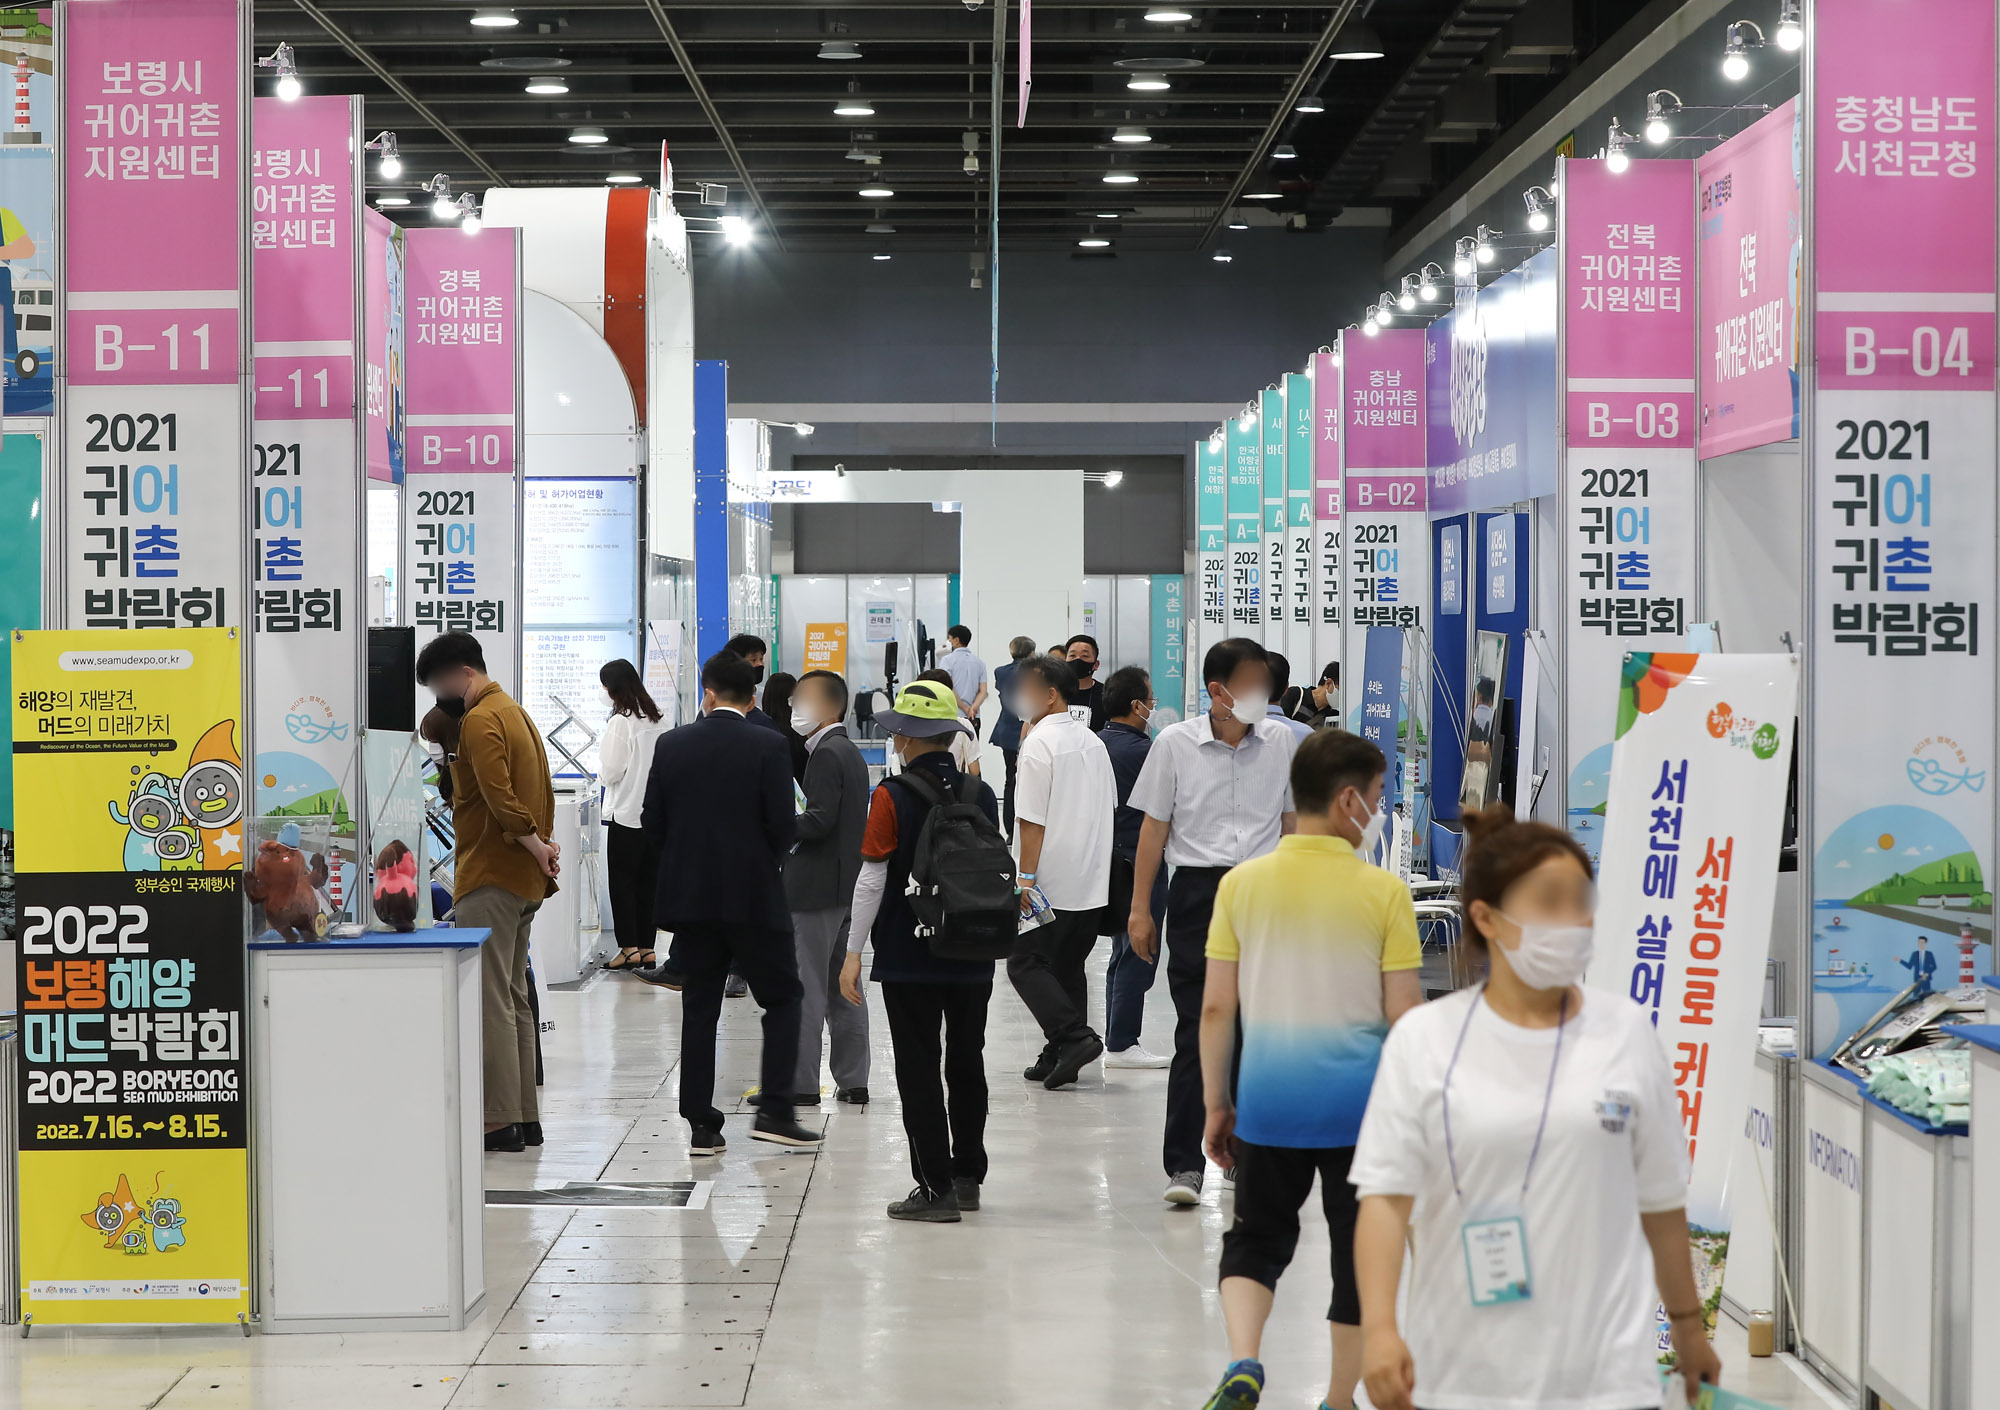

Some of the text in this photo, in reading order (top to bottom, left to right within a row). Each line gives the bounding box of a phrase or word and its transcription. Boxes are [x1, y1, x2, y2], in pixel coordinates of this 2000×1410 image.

[102, 61, 201, 96] 보령시
[84, 103, 221, 138] 귀어귀촌
[1835, 96, 1977, 133] 충청남도
[84, 145, 221, 181] 지원센터
[1835, 140, 1977, 179] 서천군청
[1606, 224, 1656, 250] 전북
[439, 270, 480, 291] 경북
[1581, 255, 1682, 282] 귀어귀촌
[1740, 232, 1757, 298] 전북
[417, 295, 503, 318] 귀어귀촌
[1581, 286, 1682, 313] 지원센터
[95, 323, 210, 372] B-11
[417, 323, 503, 346] 지원센터
[1715, 298, 1783, 383] 귀어귀촌 지원센터
[1845, 326, 1973, 377] B-04
[251, 368, 328, 408] -11
[1369, 370, 1402, 388] 충남
[1353, 389, 1418, 407] 귀어귀촌
[85, 412, 178, 453] 2021
[1353, 409, 1417, 427] 지원센터
[1587, 402, 1680, 439] B-03
[423, 434, 500, 465] B-10
[1836, 419, 1930, 461] 2021
[83, 463, 179, 516] 귀어
[552, 489, 604, 499] 허가어업현황
[1358, 482, 1416, 507] B-02
[1581, 468, 1649, 498] 2021
[1832, 473, 1931, 527] 귀어
[255, 486, 302, 530] 어
[417, 490, 475, 516] 2021
[415, 522, 476, 556] 귀어
[1237, 523, 1260, 539] A-
[1354, 524, 1398, 544] 2021
[1579, 507, 1650, 545] 귀어
[83, 524, 181, 578] 귀촌
[255, 537, 303, 581] 촌
[1234, 552, 1260, 565] 202
[1353, 548, 1399, 573] 귀어
[1832, 537, 1932, 592] 귀촌
[415, 560, 477, 594] 귀촌
[1579, 551, 1651, 591] 귀촌
[1353, 576, 1399, 602] 귀촌
[84, 586, 225, 628] 박람회
[415, 600, 504, 633] 박람회
[1353, 605, 1420, 628] 박람회
[1580, 597, 1683, 636] 박람회
[809, 632, 825, 640] 2021
[1165, 581, 1181, 678] 어촌 비즈니스
[1833, 601, 1978, 656] 박람회
[72, 655, 180, 666] www.seamudexpo.or.kr
[807, 651, 831, 661] 박람회
[808, 641, 839, 651] 귀어귀촌
[19, 689, 137, 712] 해양의 재발견,
[1367, 680, 1383, 695] 우리는
[39, 714, 170, 736] 머드의 미래가치
[1366, 703, 1391, 719] 귀어귀촌을
[134, 876, 235, 893] 정부승인 국제행사
[1630, 759, 1688, 1029] 서천에 살어
[23, 905, 149, 955] 2022
[24, 957, 196, 1010] 보령해양
[1673, 836, 1734, 1184] 서천으로 귀어
[24, 1008, 240, 1063] 머드박람회
[27, 1069, 238, 1104] 2022 BORYEONG
[123, 1091, 238, 1103] SEA MUD EXHIBITION
